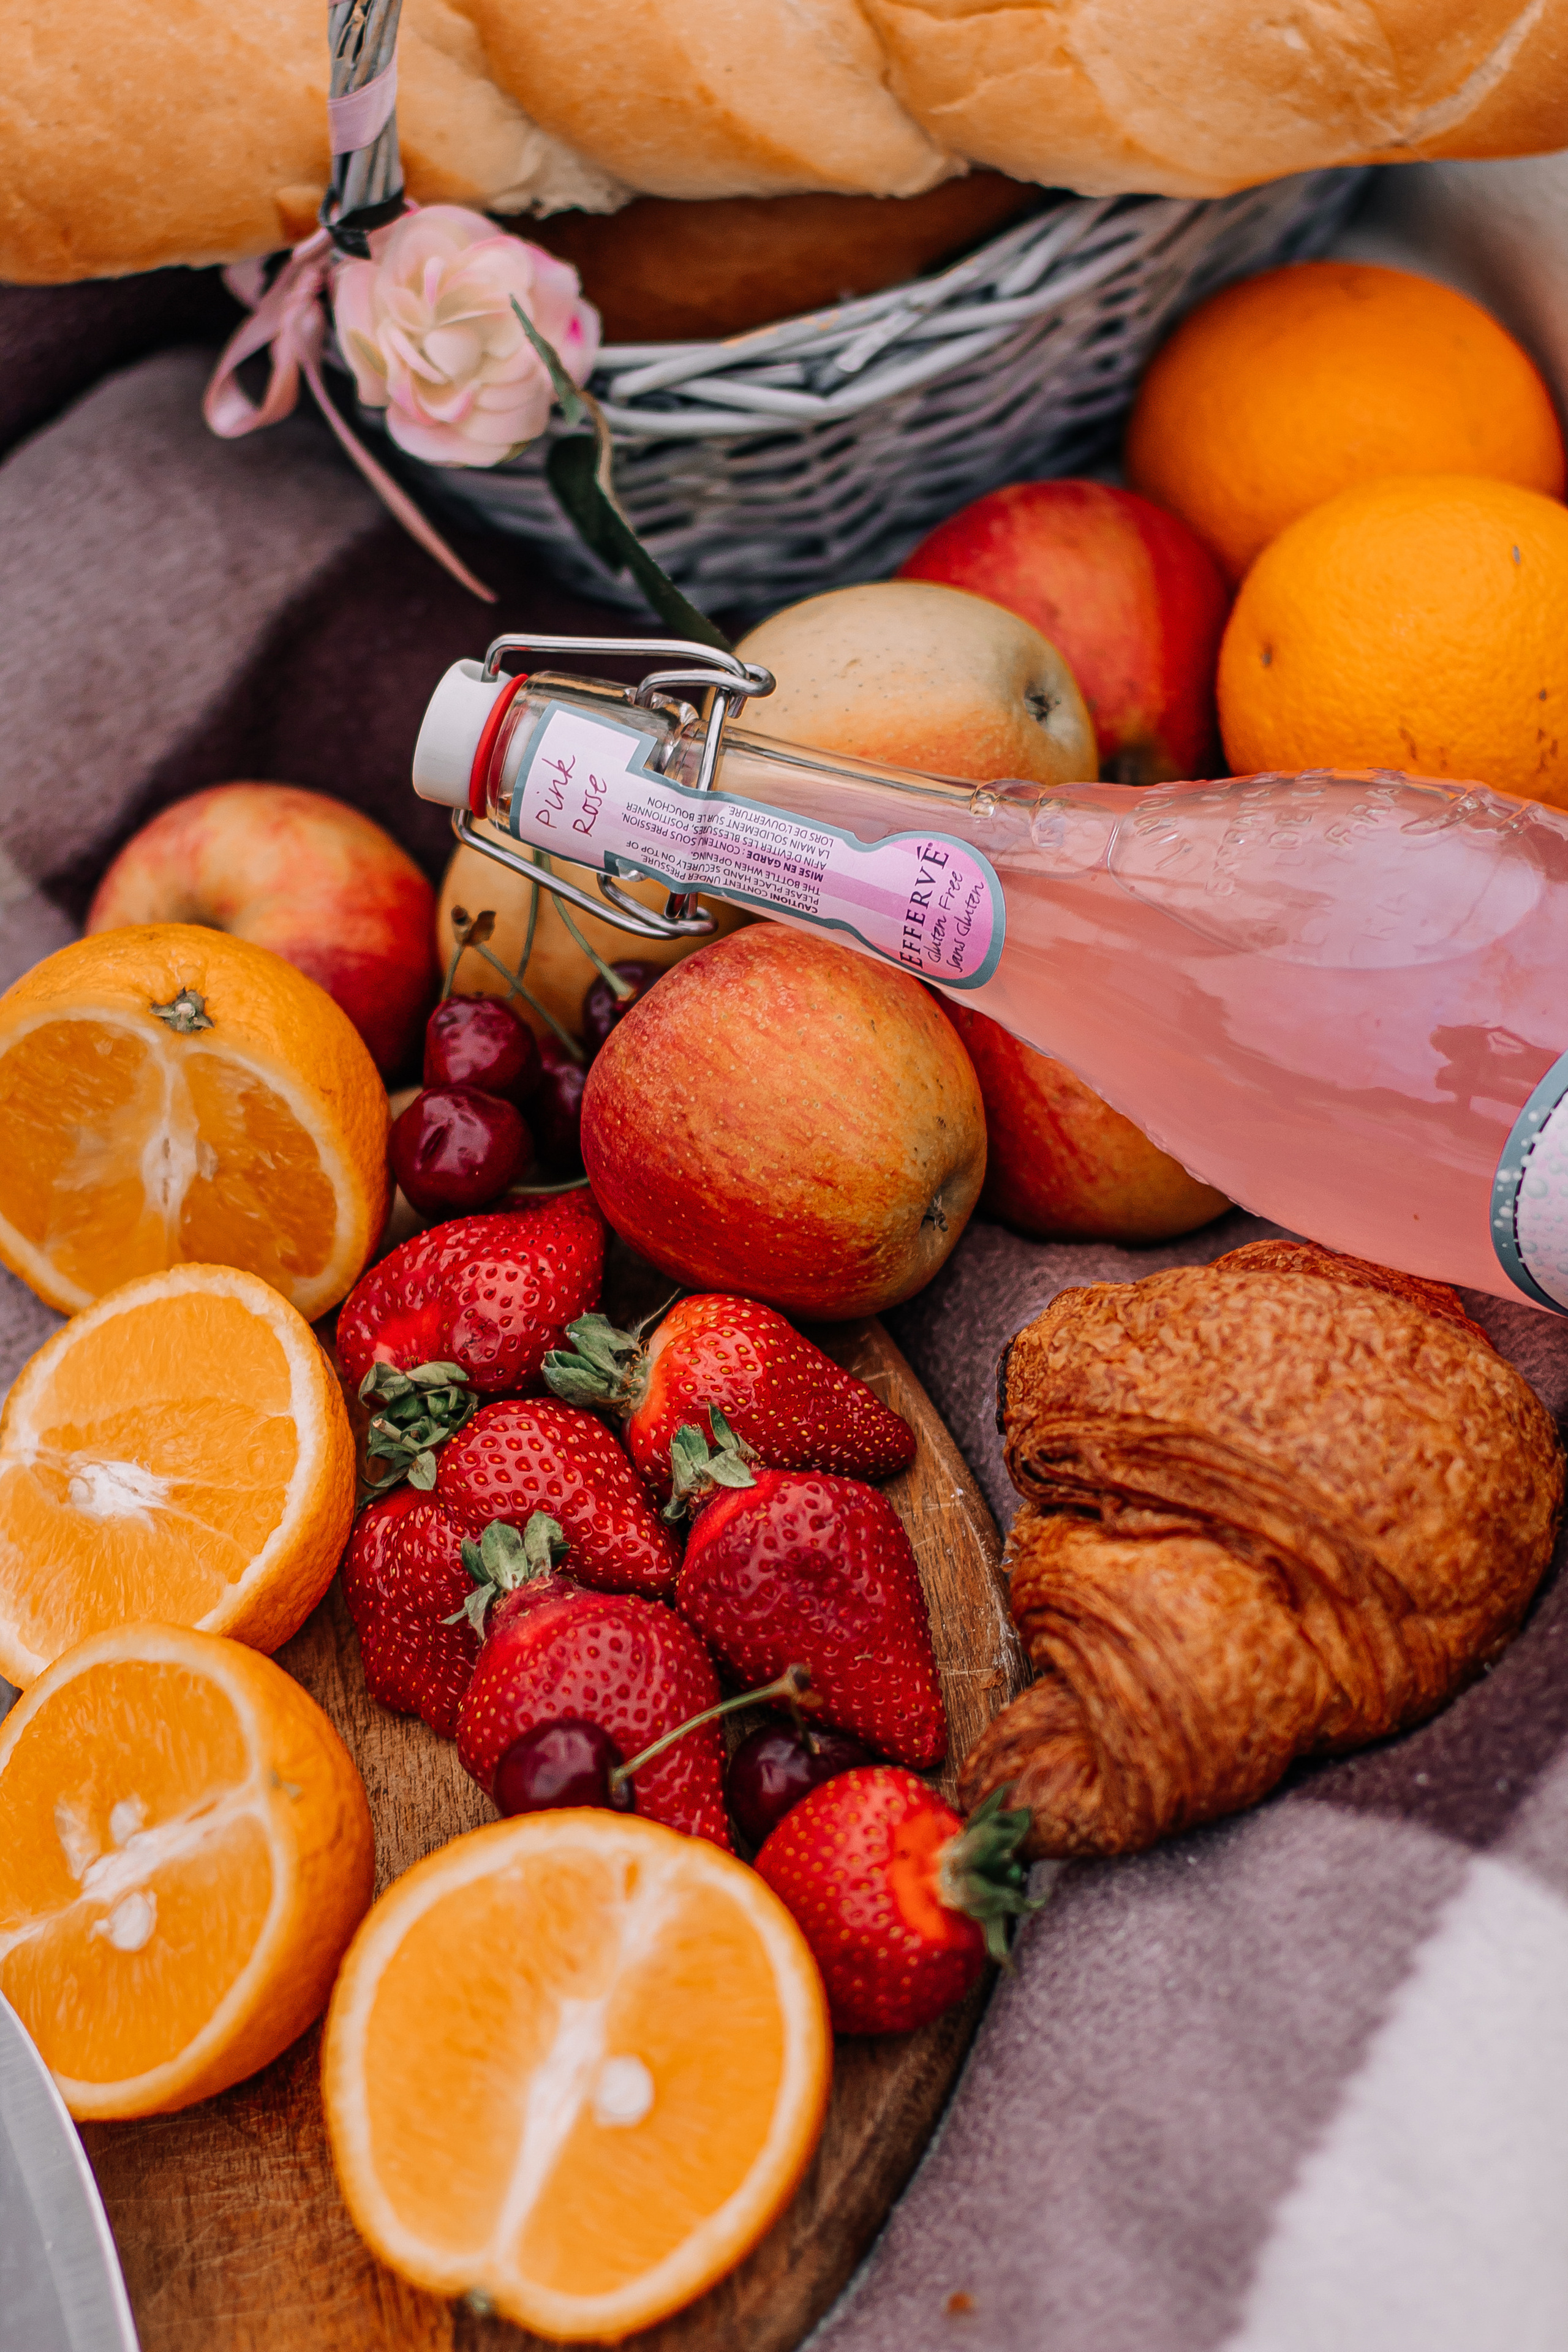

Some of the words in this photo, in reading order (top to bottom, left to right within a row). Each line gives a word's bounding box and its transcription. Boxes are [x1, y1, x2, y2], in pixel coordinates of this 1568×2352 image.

[535, 755, 576, 829] Pink
[572, 774, 607, 837] Rose
[647, 797, 695, 821] BOUCHON
[622, 812, 669, 837] PRESSION.
[626, 802, 689, 832] POSITIONNER
[696, 814, 707, 823] LE
[707, 814, 725, 826] SUR
[728, 805, 793, 834] L'OUVERTURE.
[669, 831, 697, 846] SOUS
[726, 819, 788, 846] SOLIDEMENT
[793, 827, 808, 839] DE
[809, 832, 834, 848] LORS
[625, 840, 639, 850] OF
[698, 837, 741, 855] CONTENU
[742, 836, 759, 850] LES
[789, 839, 816, 855] MAIN
[641, 846, 659, 858] TOP
[661, 851, 676, 863] ON
[691, 851, 733, 867] OPENING.
[746, 850, 782, 869] GARDE
[818, 848, 830, 860] LA
[641, 854, 687, 880] PRESSURE.
[676, 859, 721, 873] SECURELY
[734, 861, 763, 877] WHEN
[783, 862, 797, 874] EN
[803, 856, 827, 871] AFIN
[687, 873, 721, 884] UNDER
[723, 868, 752, 883] HAND
[765, 870, 801, 889] BOTTLE
[798, 867, 824, 883] MISE
[723, 878, 768, 897] CONTENT
[753, 878, 783, 894] PLACE
[802, 883, 820, 896] THE
[785, 888, 820, 906] PLEASE
[899, 843, 949, 969] EFFERVÉ
[954, 881, 984, 937] Gluten
[923, 915, 947, 963] Gluten
[938, 870, 963, 911] Free
